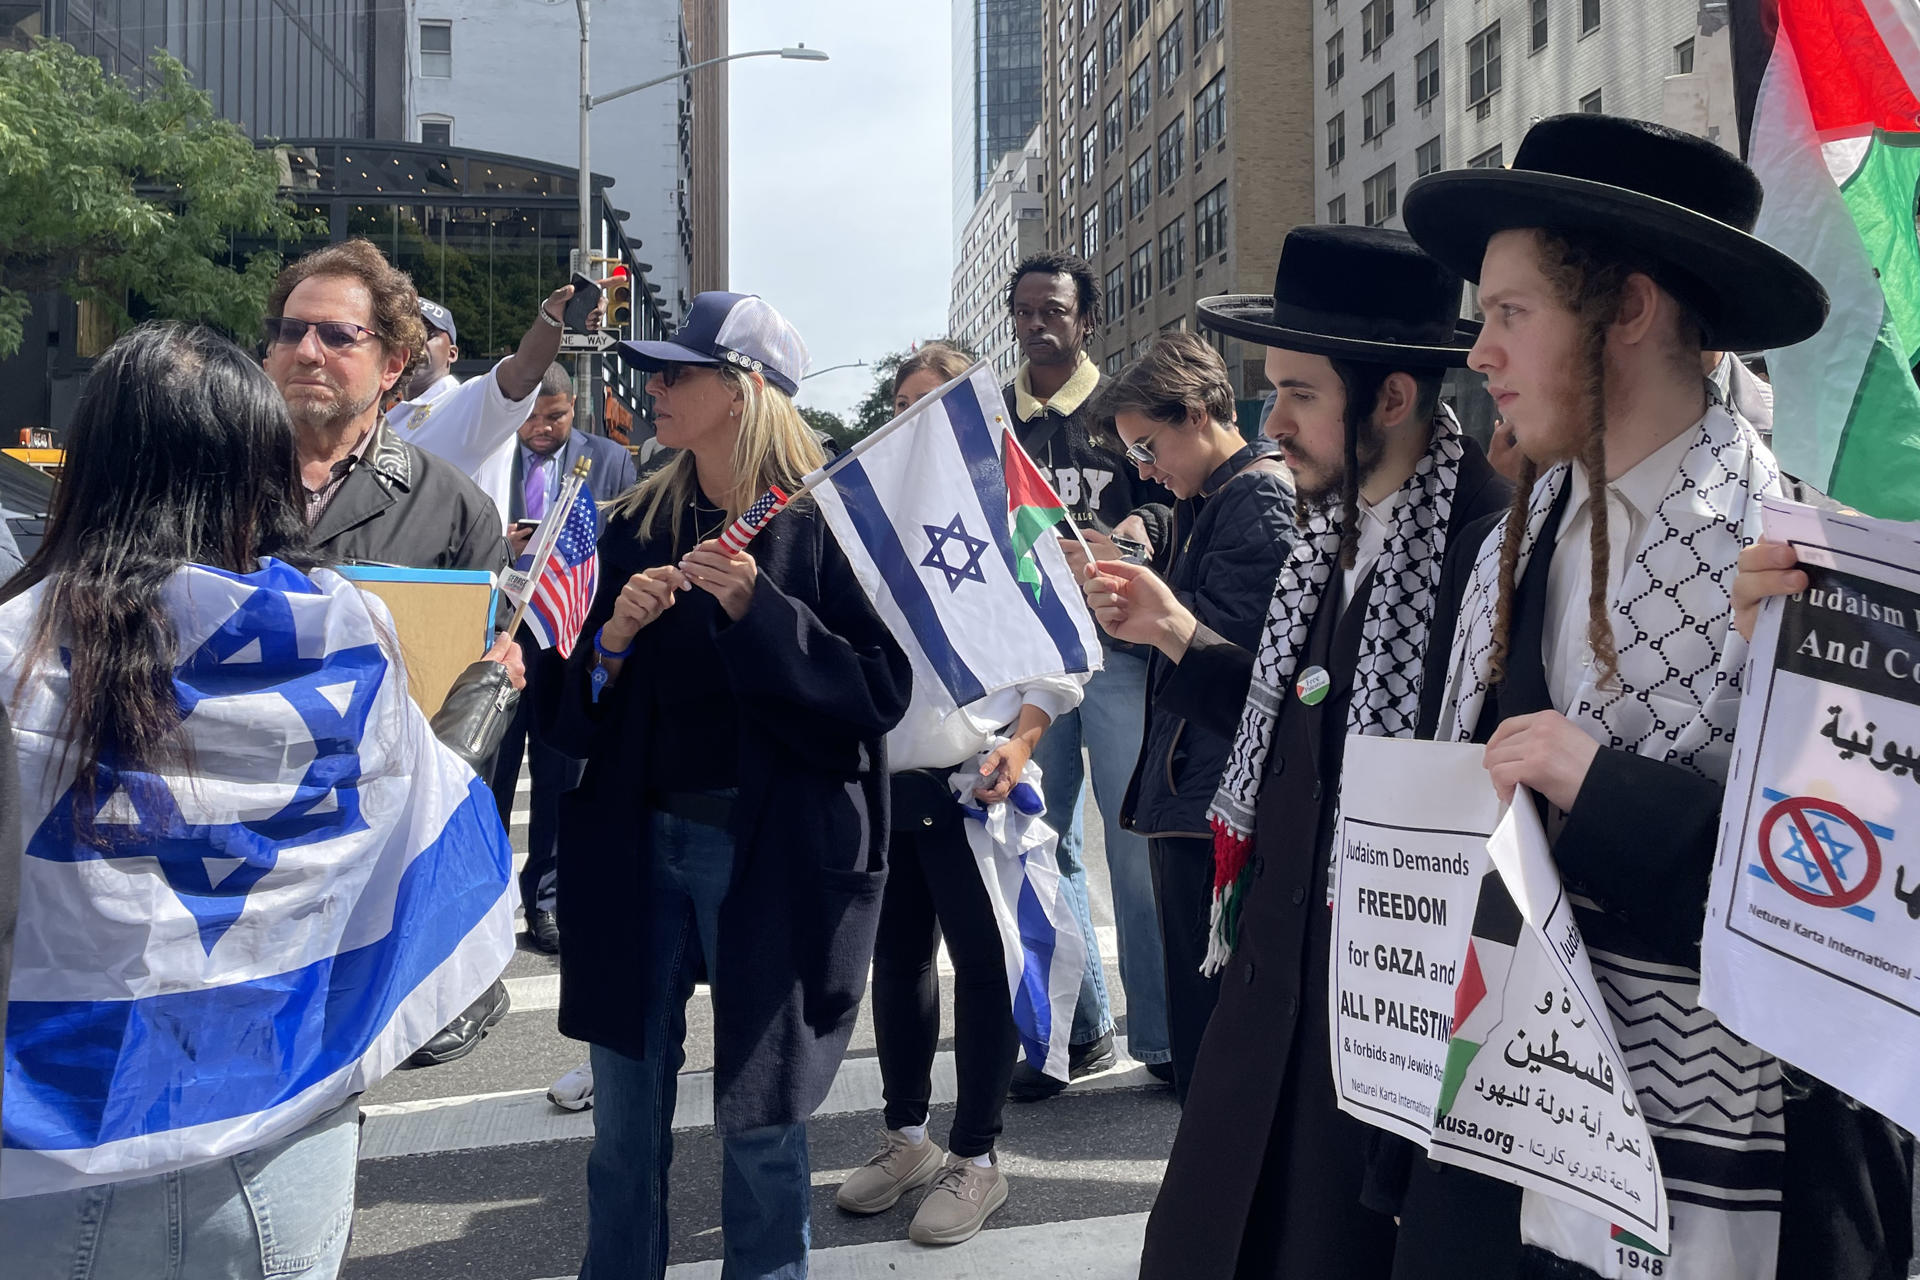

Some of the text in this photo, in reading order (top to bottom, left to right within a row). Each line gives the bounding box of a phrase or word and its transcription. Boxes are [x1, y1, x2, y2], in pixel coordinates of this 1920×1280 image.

[419, 300, 444, 318] PD
[561, 335, 607, 345] NE WAY
[1040, 466, 1113, 510] BY
[1797, 629, 1870, 669] And
[1346, 840, 1469, 876] Judaism Demands
[1359, 887, 1447, 927] FREEDOM
[1748, 903, 1790, 930] Neturei
[1793, 922, 1825, 945] Karta
[1828, 936, 1912, 980] International
[1349, 940, 1456, 986] for GAZA and
[1340, 990, 1369, 1022] ALL
[1344, 1036, 1351, 1053] &
[1353, 1040, 1387, 1062] forbids
[1389, 1051, 1406, 1071] any
[1407, 1057, 1433, 1076] Jewish
[1504, 1030, 1614, 1095] فلسطين
[1379, 1086, 1397, 1104] Karta
[1475, 1077, 1530, 1107] لليهود
[1535, 1088, 1573, 1124] دولة
[1434, 1108, 1514, 1154] kusa.org
[1616, 1247, 1663, 1276] 1948
